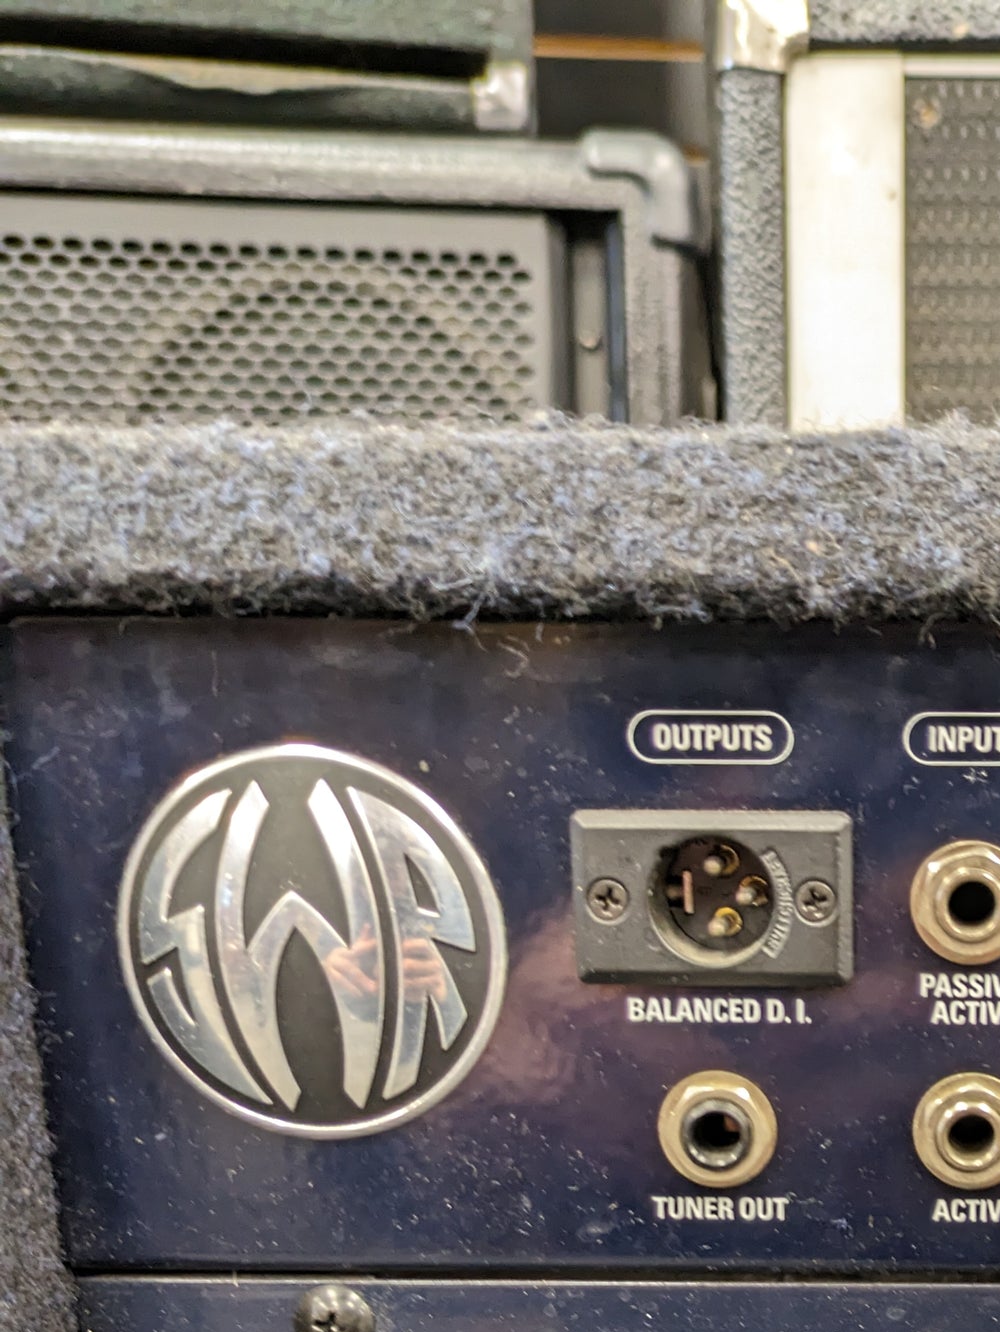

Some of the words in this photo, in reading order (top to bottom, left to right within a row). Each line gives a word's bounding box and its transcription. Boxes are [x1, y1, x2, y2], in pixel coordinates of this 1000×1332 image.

[653, 724, 772, 751] OUTPUTS
[140, 778, 475, 1112] SWR
[627, 997, 761, 1022] BALANCED
[651, 1196, 734, 1220] TUNER
[739, 1197, 789, 1220] OUT
